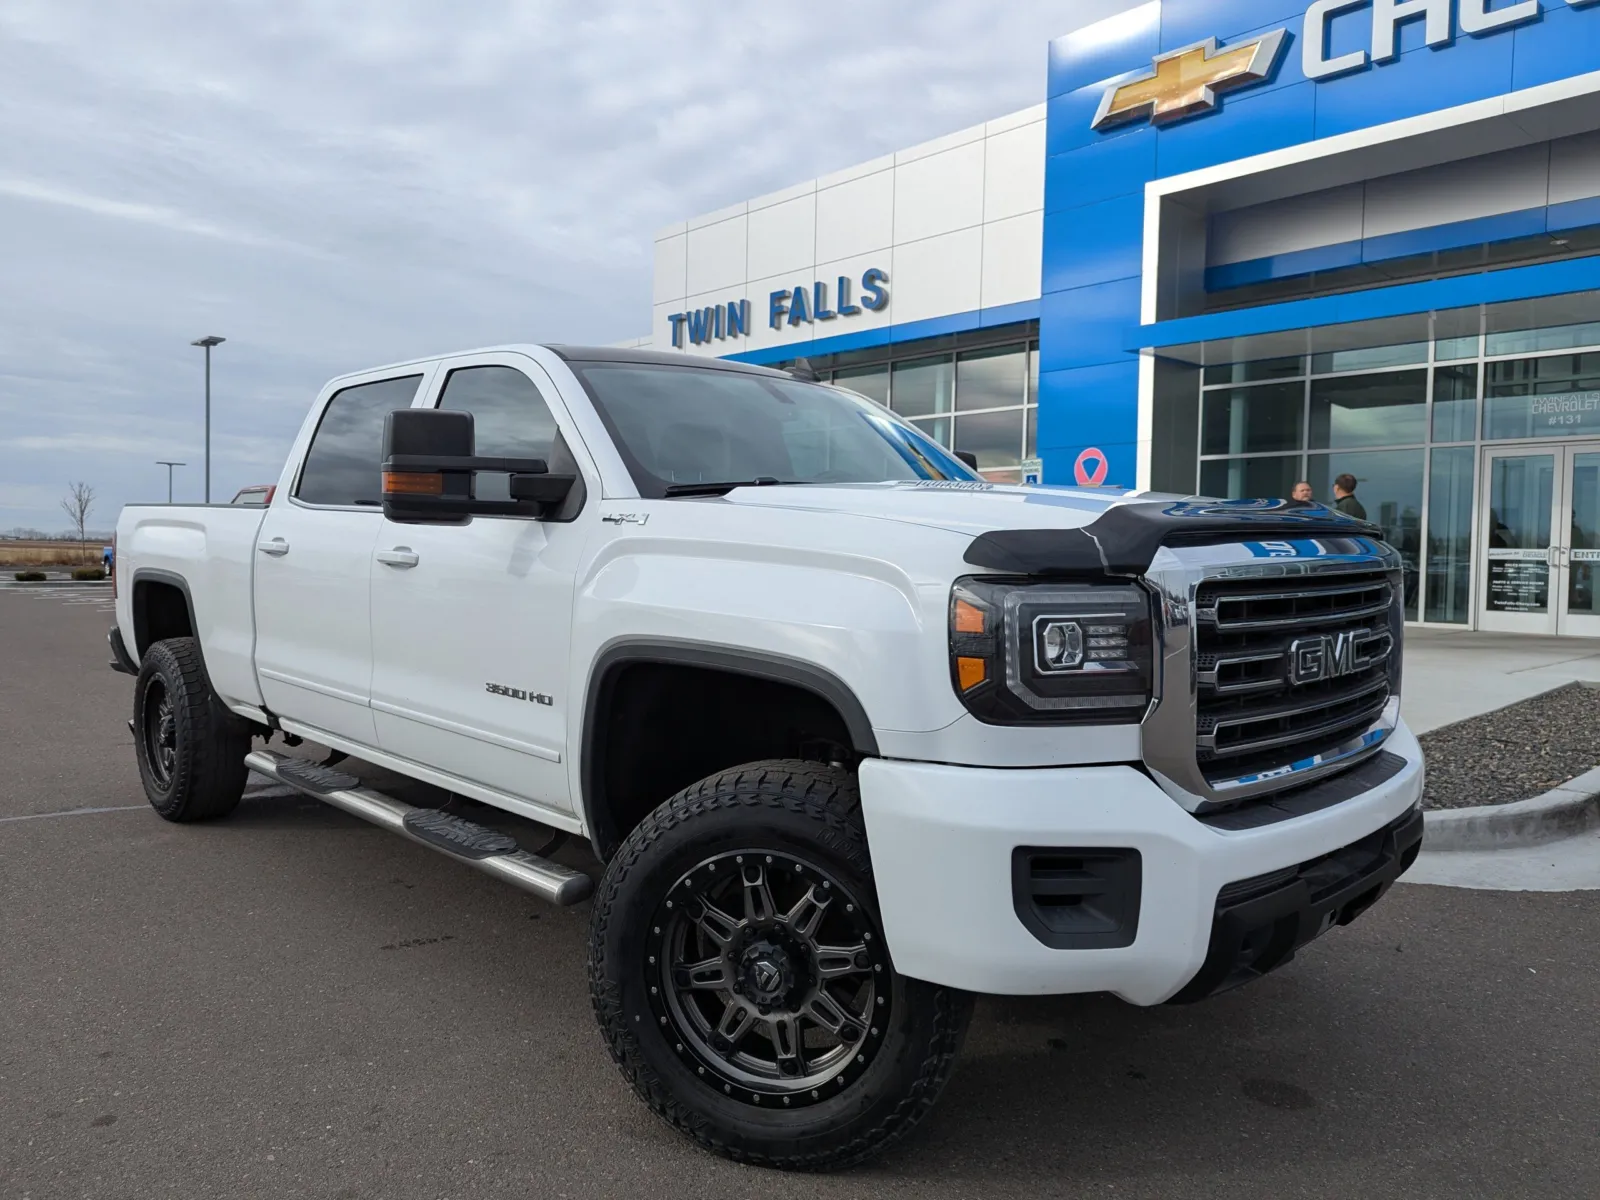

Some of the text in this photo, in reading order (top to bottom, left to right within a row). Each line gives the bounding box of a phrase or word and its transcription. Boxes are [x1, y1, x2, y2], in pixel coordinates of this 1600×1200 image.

[1302, 0, 1600, 80] CH
[667, 267, 889, 349] TWIN FALLS
[1531, 399, 1600, 415] CHEVROLET
[1548, 414, 1582, 426] #131
[1288, 627, 1373, 686] GMC
[485, 682, 554, 707] 3500 HD
